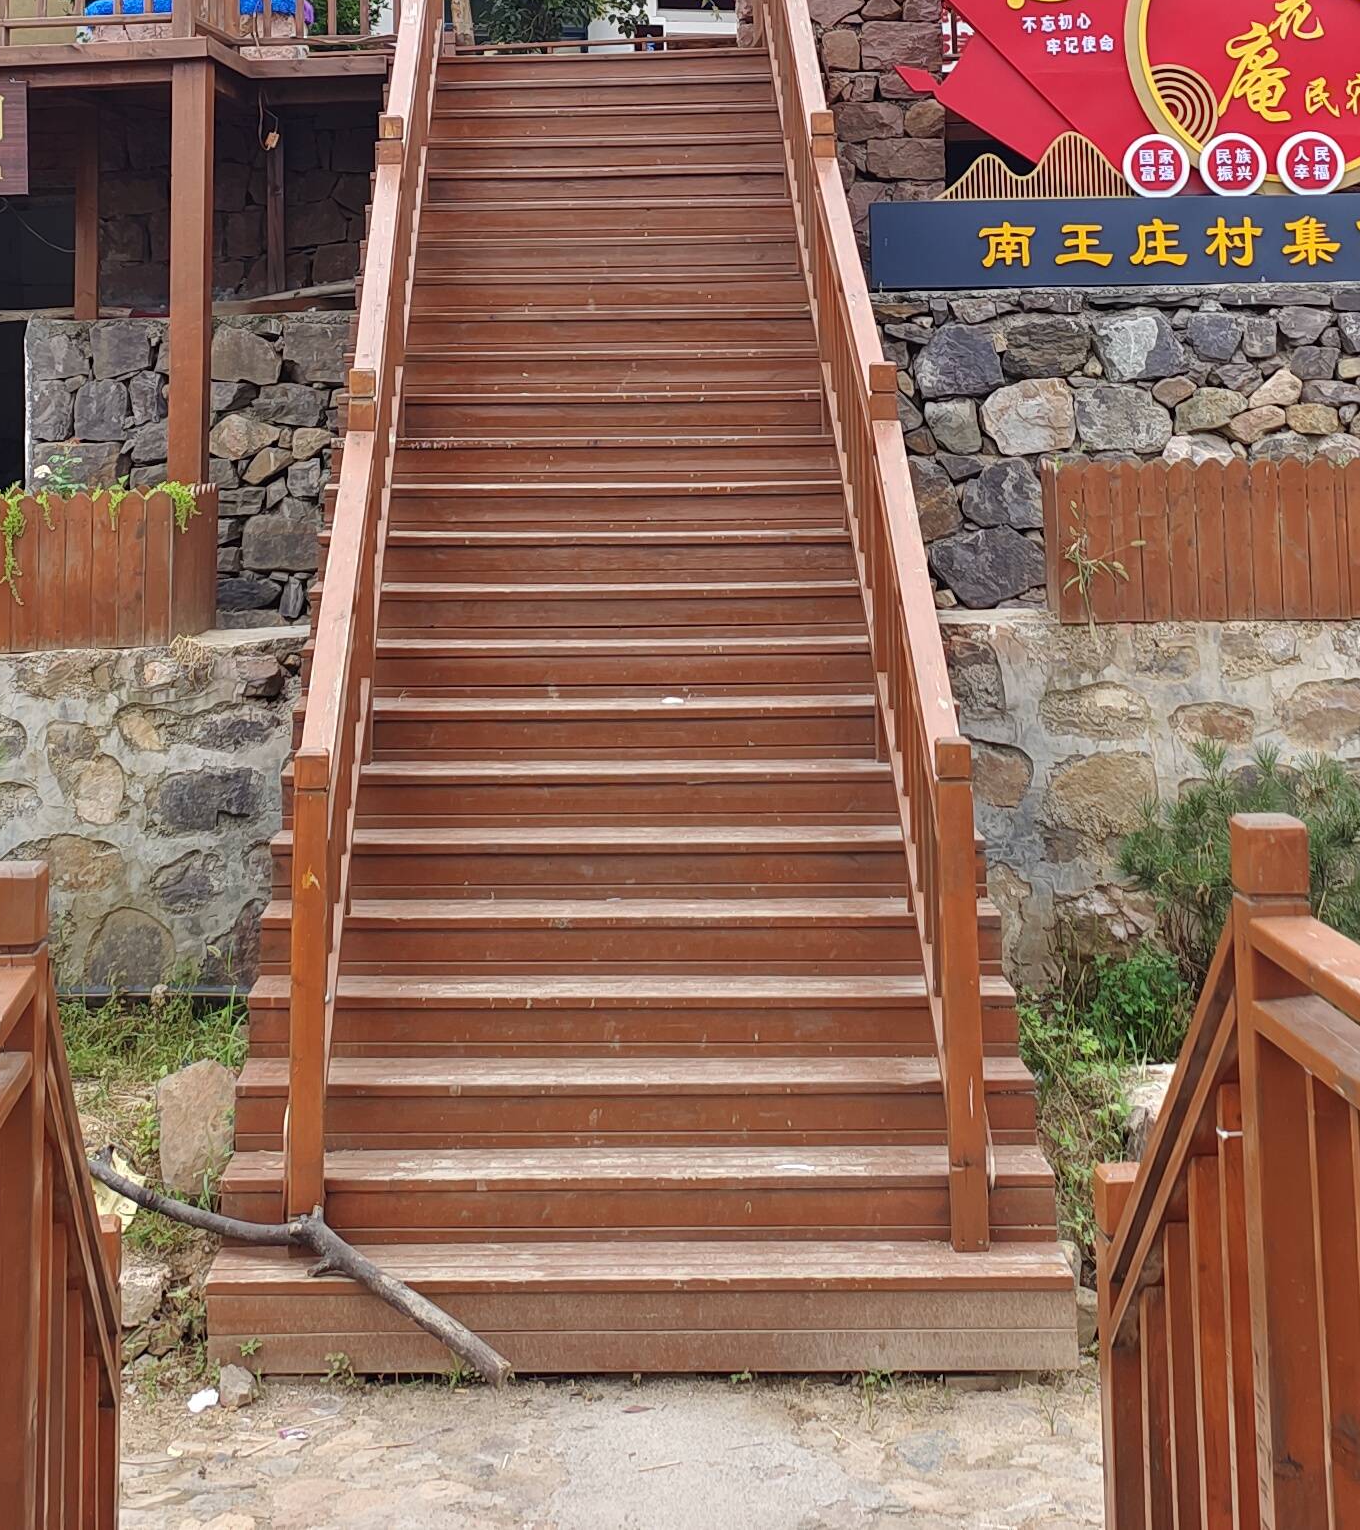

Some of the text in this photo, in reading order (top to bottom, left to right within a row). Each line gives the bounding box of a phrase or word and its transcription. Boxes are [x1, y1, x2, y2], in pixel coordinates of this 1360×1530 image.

[1021, 12, 1092, 34] 不忘初心
[1045, 34, 1114, 56] 牢记使命
[1139, 148, 1175, 165] 国家
[1215, 148, 1252, 164] 民族
[1294, 146, 1331, 162] 人民
[1139, 165, 1175, 182] 富强
[1216, 165, 1252, 182] 振兴
[1294, 163, 1331, 180] 幸福
